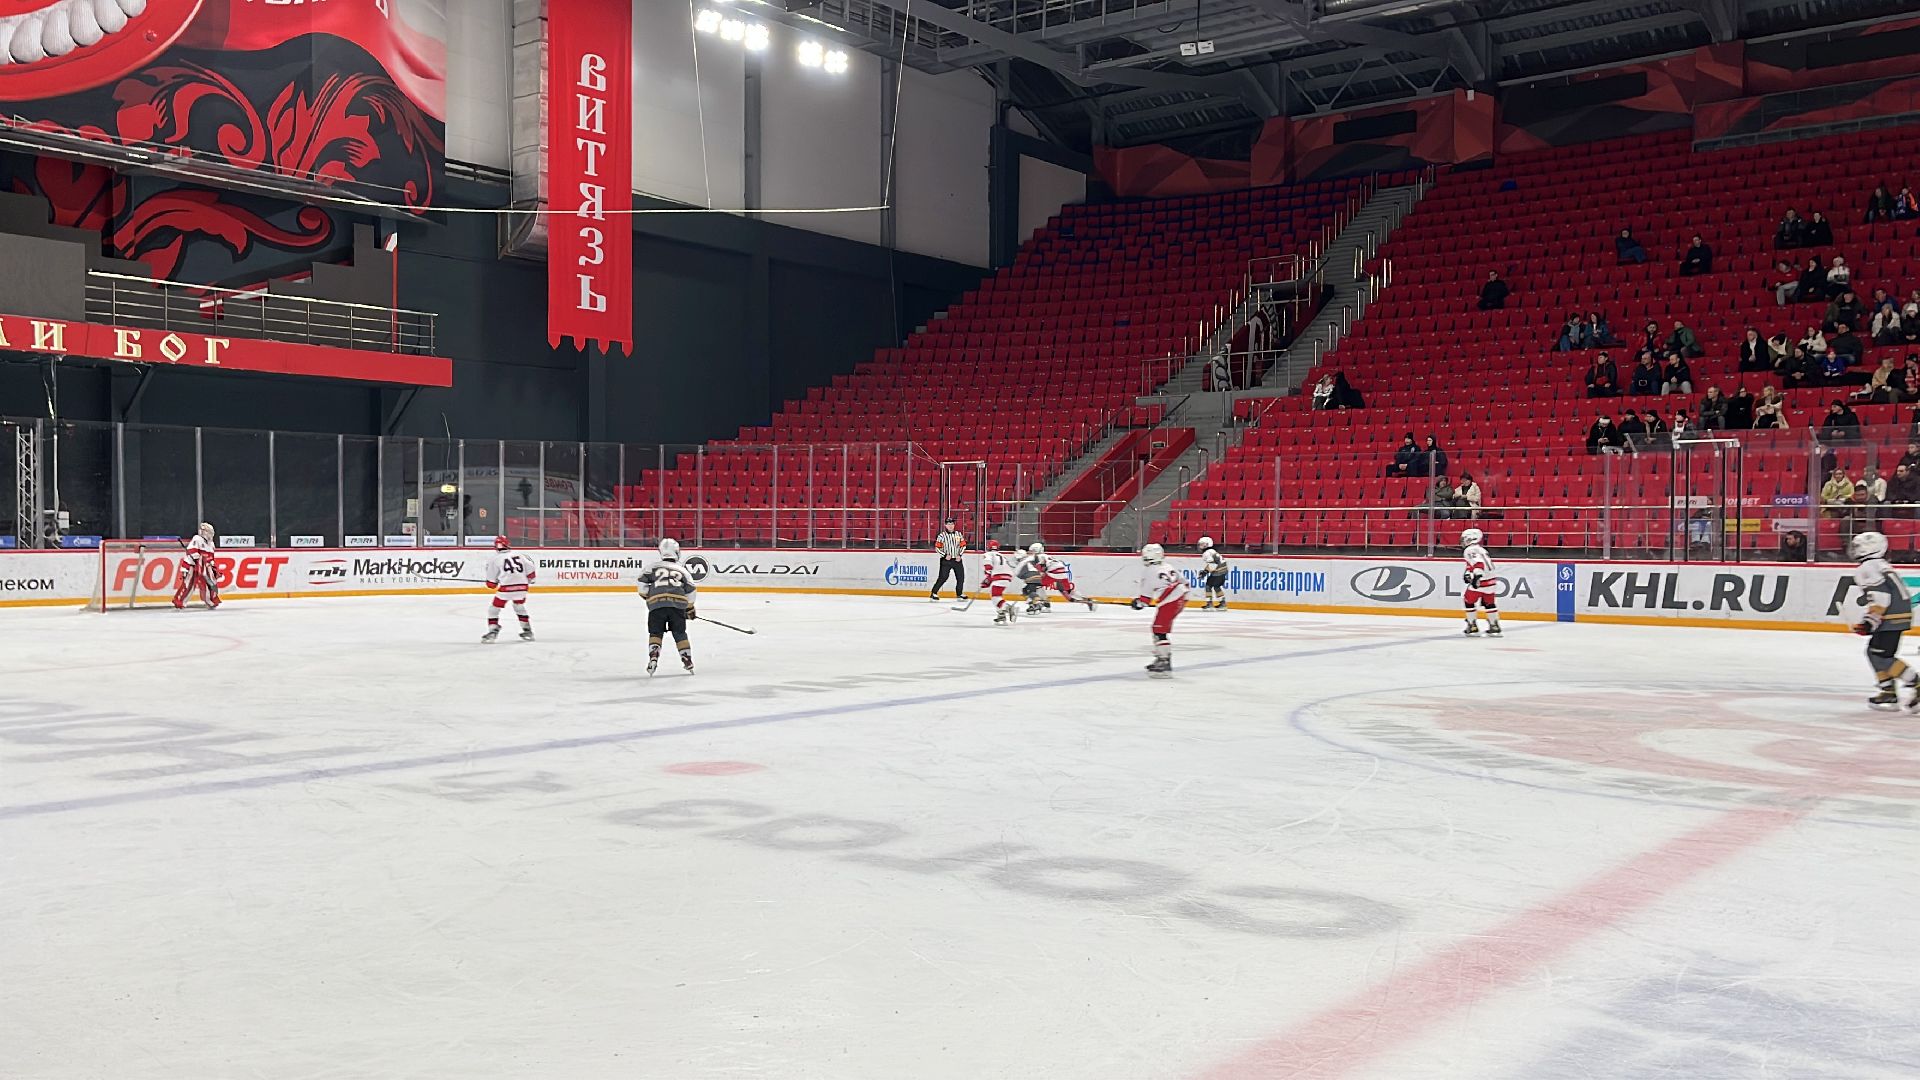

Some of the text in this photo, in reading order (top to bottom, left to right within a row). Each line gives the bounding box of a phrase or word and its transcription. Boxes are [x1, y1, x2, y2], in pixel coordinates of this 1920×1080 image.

[576, 53, 607, 313] ВИТЯЗЬ
[114, 328, 230, 364] БОГ
[353, 558, 464, 578] MarkHockey
[503, 556, 523, 573] 45
[539, 557, 643, 568] БИЛЕТЫ ОНЛАЙН
[712, 564, 819, 575] VALDAI
[899, 565, 928, 575] ГАЗПРОМ
[113, 557, 289, 591] FOBET
[557, 571, 619, 580] HCVITYAZ.RU
[654, 567, 683, 587] 23
[1446, 576, 1534, 599] LDA
[1588, 571, 1790, 613] KHL.RU
